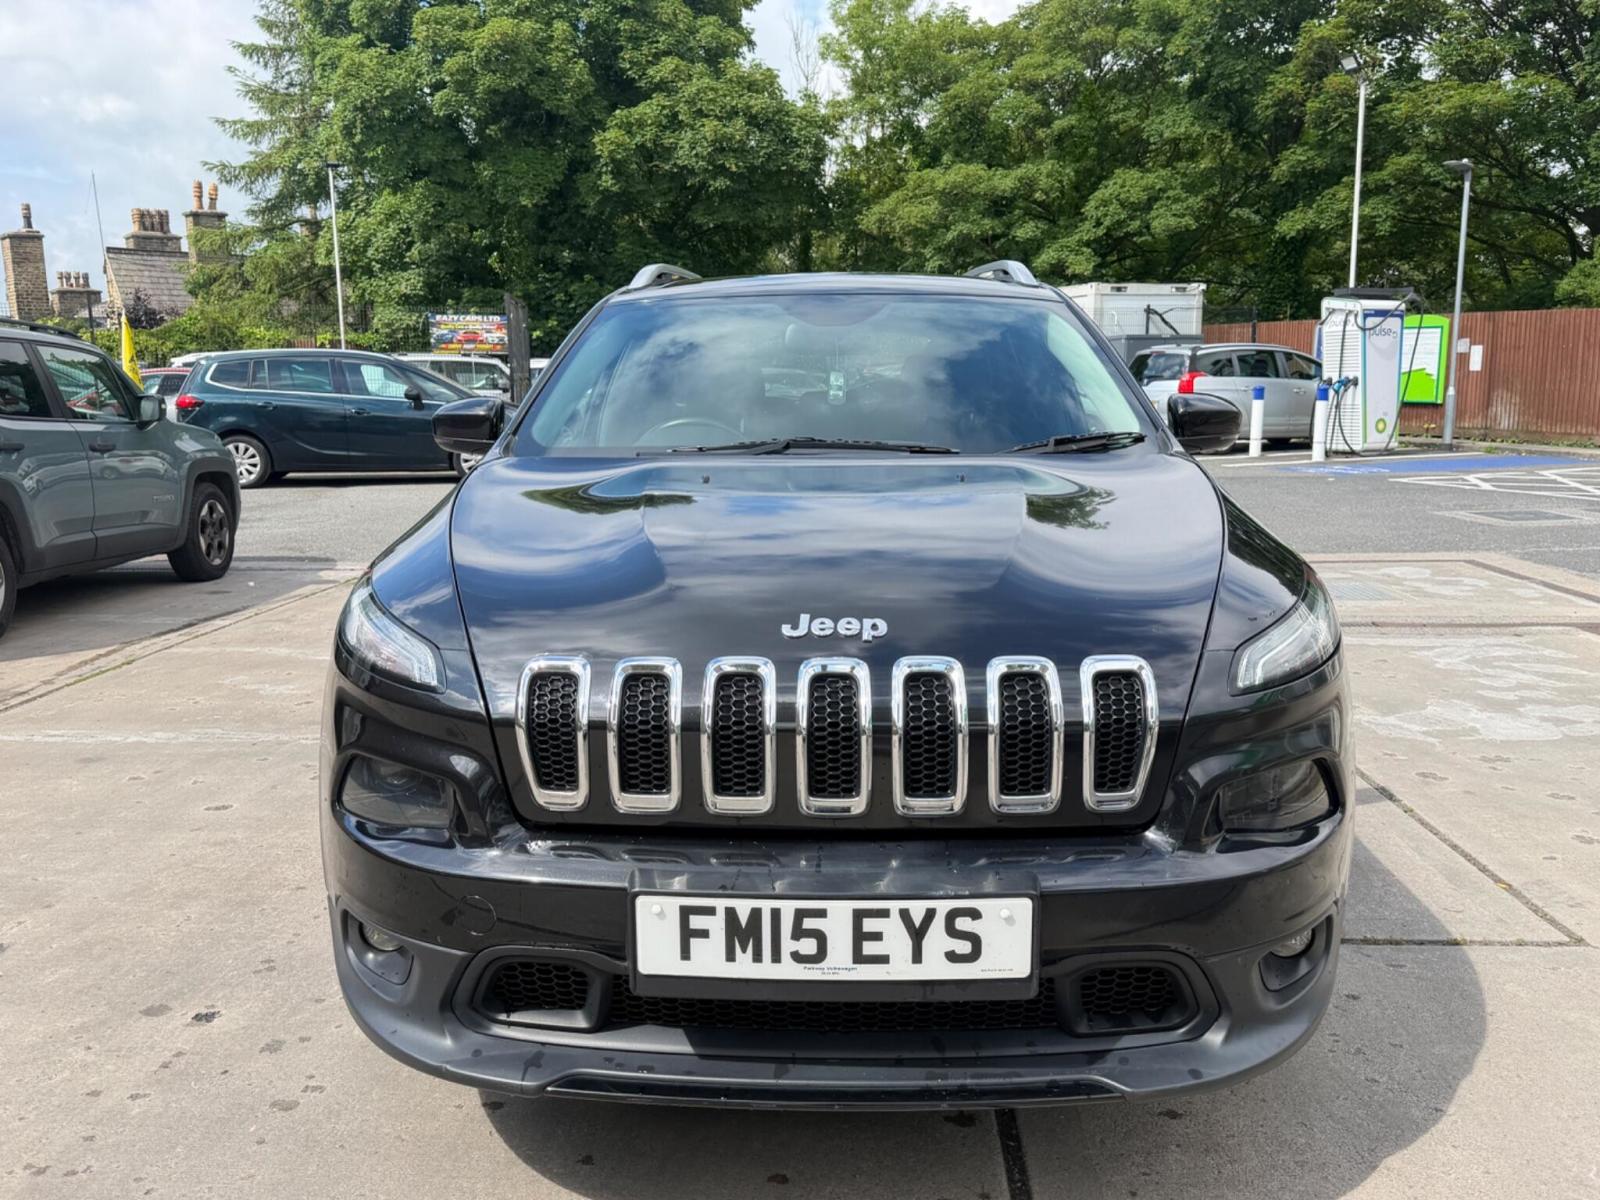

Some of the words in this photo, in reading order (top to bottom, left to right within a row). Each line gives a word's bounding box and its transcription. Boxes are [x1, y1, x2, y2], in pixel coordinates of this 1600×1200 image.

[460, 314, 483, 322] CARS
[485, 314, 501, 322] LTD
[781, 613, 888, 643] Jeep
[679, 904, 828, 965] FM15
[852, 906, 983, 964] EYS
